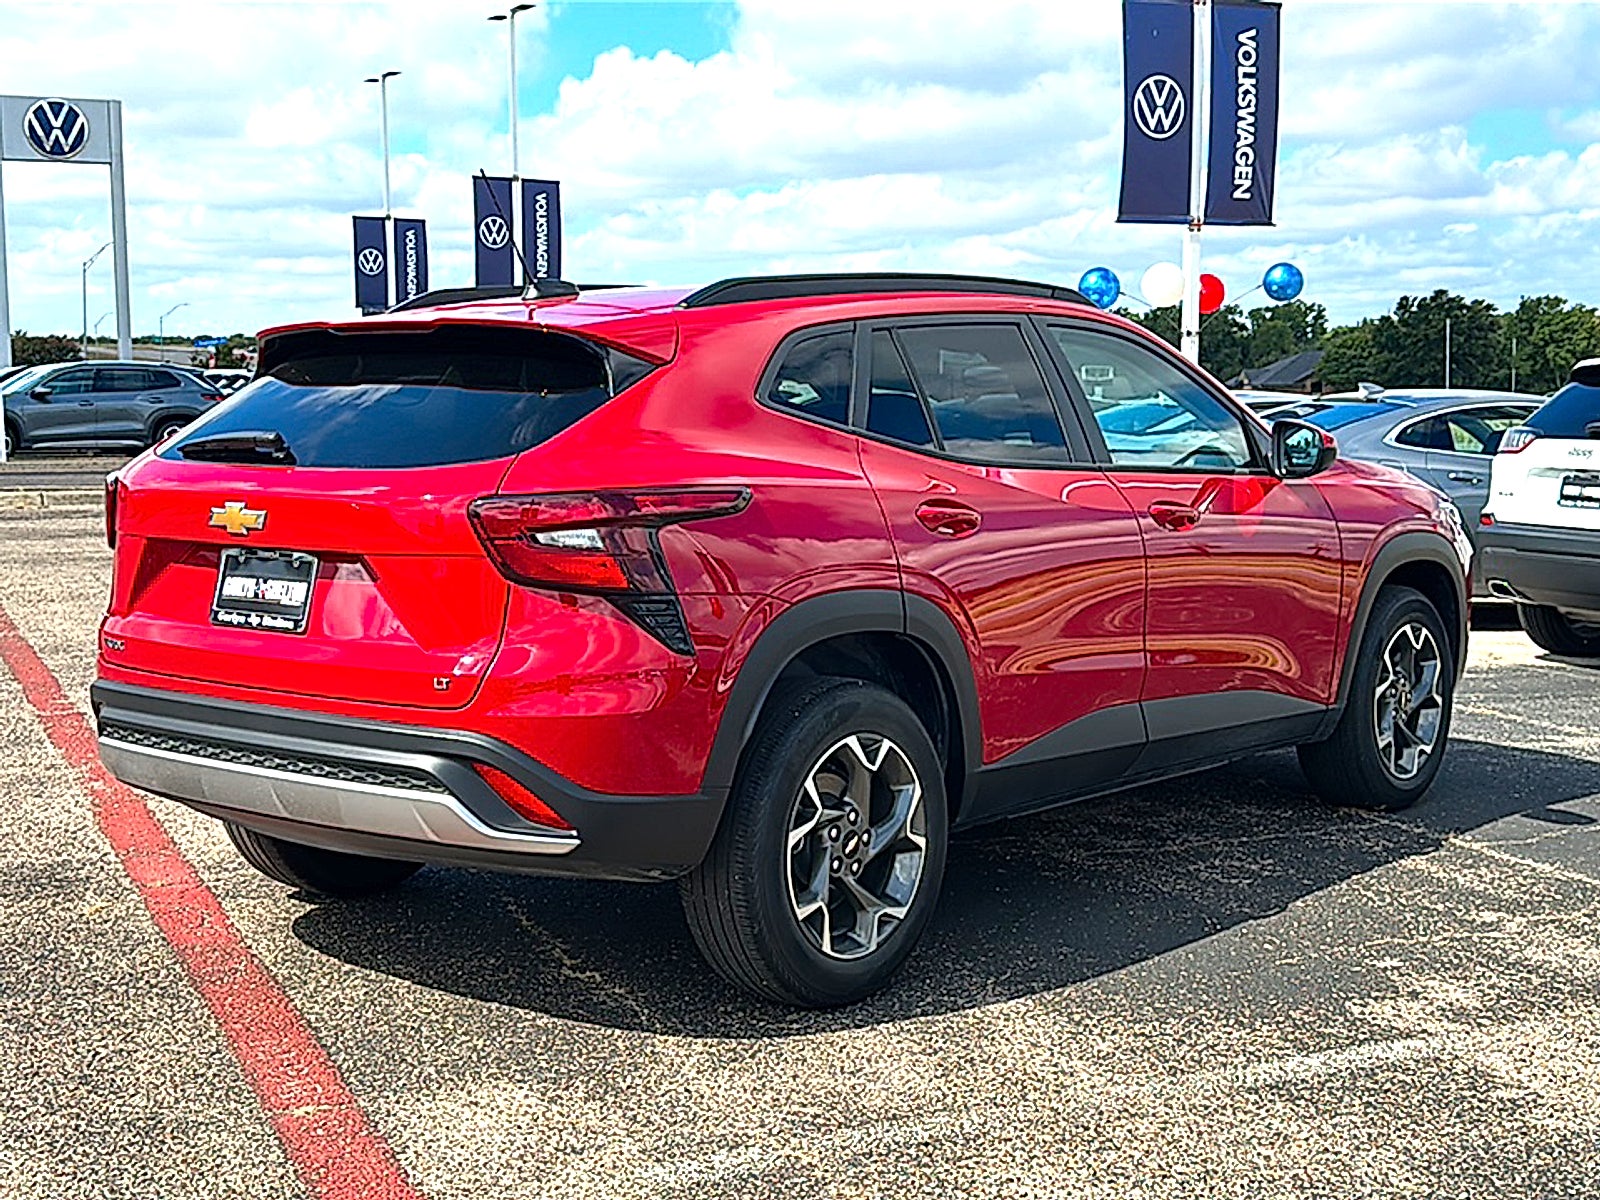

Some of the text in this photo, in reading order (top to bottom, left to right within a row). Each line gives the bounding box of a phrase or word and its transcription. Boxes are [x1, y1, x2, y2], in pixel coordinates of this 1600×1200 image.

[24, 98, 88, 158] VW
[1133, 74, 1185, 139] VW
[1232, 28, 1257, 200] VOLKSWAGEN
[535, 192, 548, 278] VOLKSWAGEN
[433, 677, 450, 690] LT
